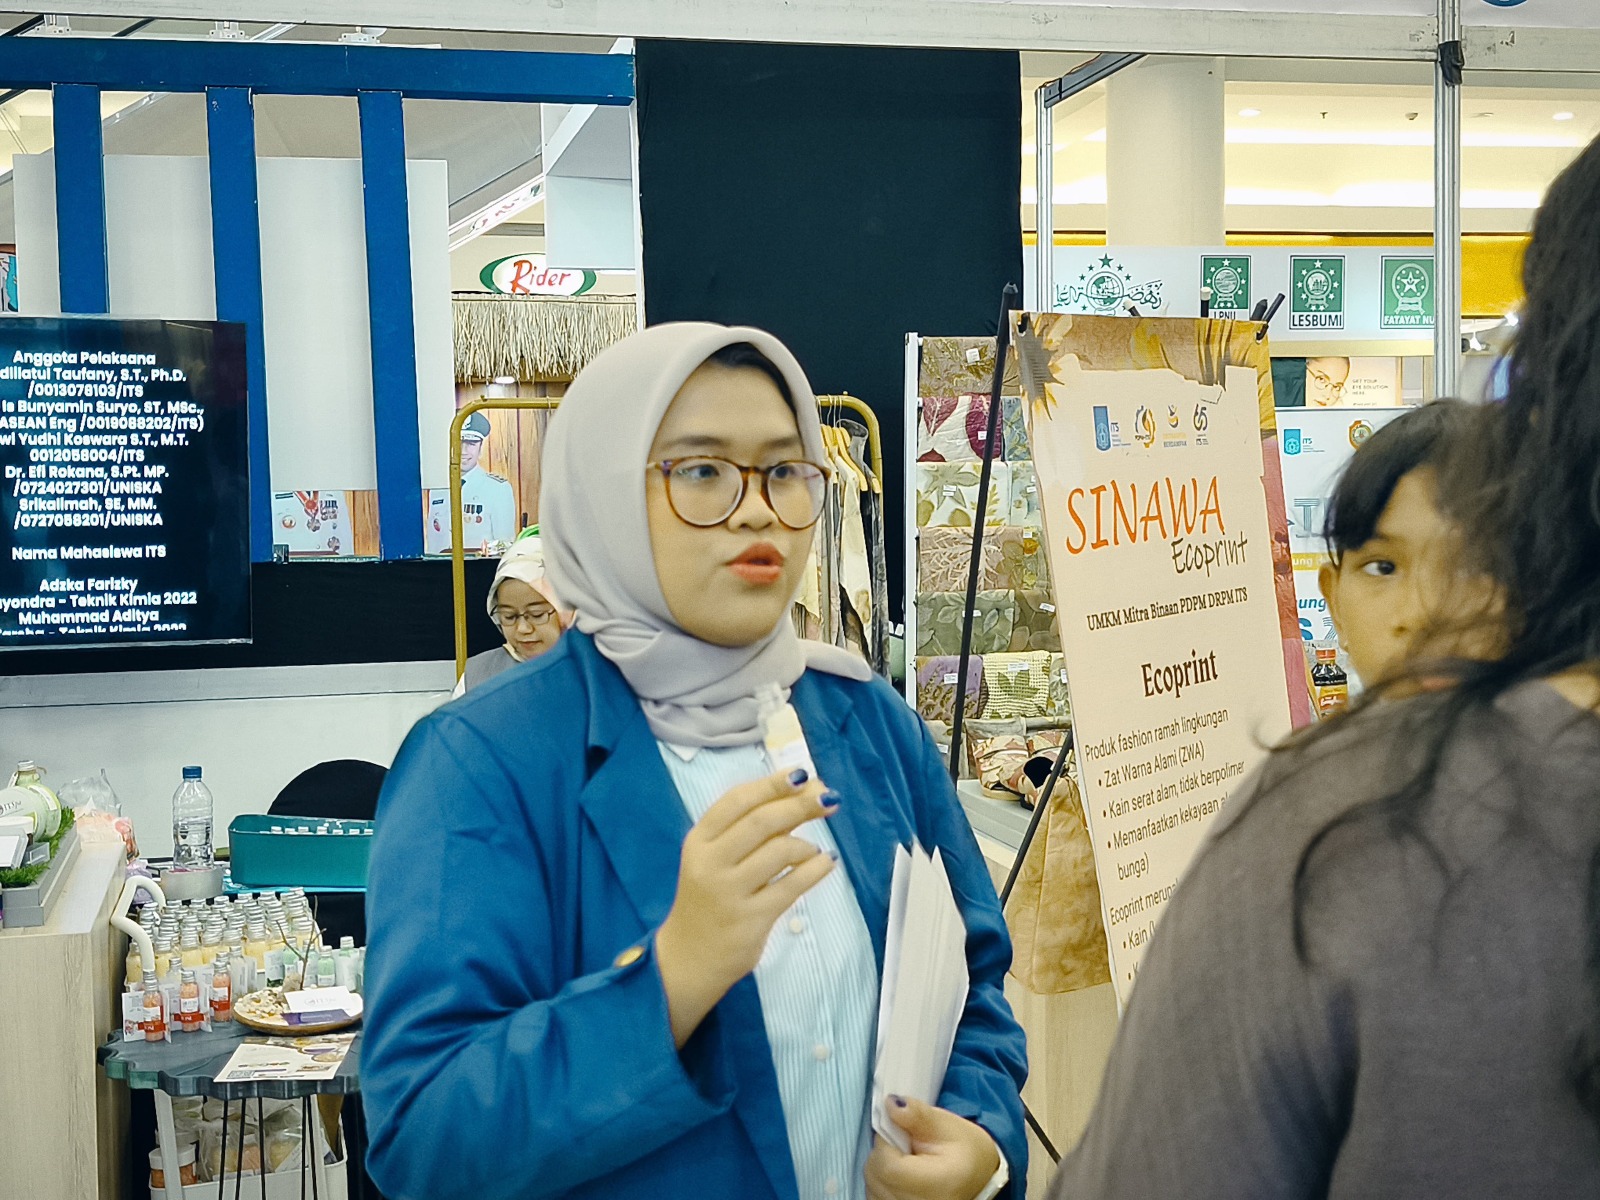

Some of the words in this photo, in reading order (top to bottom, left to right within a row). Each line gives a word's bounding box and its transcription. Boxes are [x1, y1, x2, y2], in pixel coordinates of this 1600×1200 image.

[510, 259, 571, 295] Rider
[1292, 314, 1342, 327] LESBUMI
[1384, 315, 1421, 325] FATAYAT
[13, 350, 77, 367] Anggota
[80, 351, 156, 365] Pelaksana
[53, 368, 118, 383] Taufany,
[120, 369, 149, 382] S.T.,
[151, 369, 187, 382] Ph.D.
[18, 400, 93, 416] Bunyamin
[96, 401, 141, 416] Suryo,
[144, 401, 165, 415] ST,
[168, 402, 205, 416] MSc.,
[0, 417, 47, 430] ASEAN
[50, 417, 76, 432] Eng
[1110, 422, 1120, 432] ITS
[18, 433, 61, 446] Yudhi
[64, 434, 127, 447] Koswara
[130, 434, 158, 448] S.T.,
[161, 434, 189, 447] M.T.
[1302, 437, 1313, 445] ITS
[5, 466, 26, 479] Dr.
[49, 466, 108, 480] Rokana,
[111, 466, 141, 479] S.Pt.
[144, 466, 169, 478] MP.
[105, 497, 125, 511] SE,
[127, 498, 157, 510] MM.
[1066, 476, 1226, 556] SINAWA
[12, 547, 57, 560] Nama
[60, 545, 142, 560] Mahasiswa
[145, 545, 167, 558] ITS
[1171, 531, 1248, 577] Ecoprint
[39, 578, 84, 592] Adzka
[87, 577, 138, 594] Farizky
[69, 593, 117, 607] Teknik
[119, 591, 161, 606] Kimia
[163, 591, 198, 605] 2022
[18, 610, 109, 626] Muhammad
[112, 609, 159, 625] Aditya
[1087, 610, 1122, 631] UMKM
[1123, 606, 1149, 624] Mitra
[1150, 602, 1179, 620] Binaan
[1179, 594, 1207, 614] PDPM
[1207, 589, 1235, 608] DRPM
[1235, 587, 1248, 602] ITS
[1141, 649, 1219, 698] Ecoprint
[1085, 734, 1117, 762] Produk
[1118, 730, 1154, 752] fashion
[1154, 719, 1181, 742] ramah
[1181, 708, 1229, 734] lingkungan
[1104, 767, 1121, 788] Zat
[1122, 761, 1152, 783] Warna
[1154, 754, 1178, 774] Alami
[1178, 740, 1205, 767] (ZWA)
[1108, 799, 1131, 819] Kain
[1131, 789, 1155, 811] serat
[1156, 784, 1180, 803] alam,
[1179, 775, 1200, 795] tidak
[1200, 761, 1245, 786] berpolimer
[1113, 813, 1180, 850] Memanfaatkan
[1180, 798, 1220, 825] kekayaan
[1117, 852, 1150, 881] bunga)
[1110, 895, 1144, 926] Ecoprint
[1128, 926, 1149, 949] Kain
